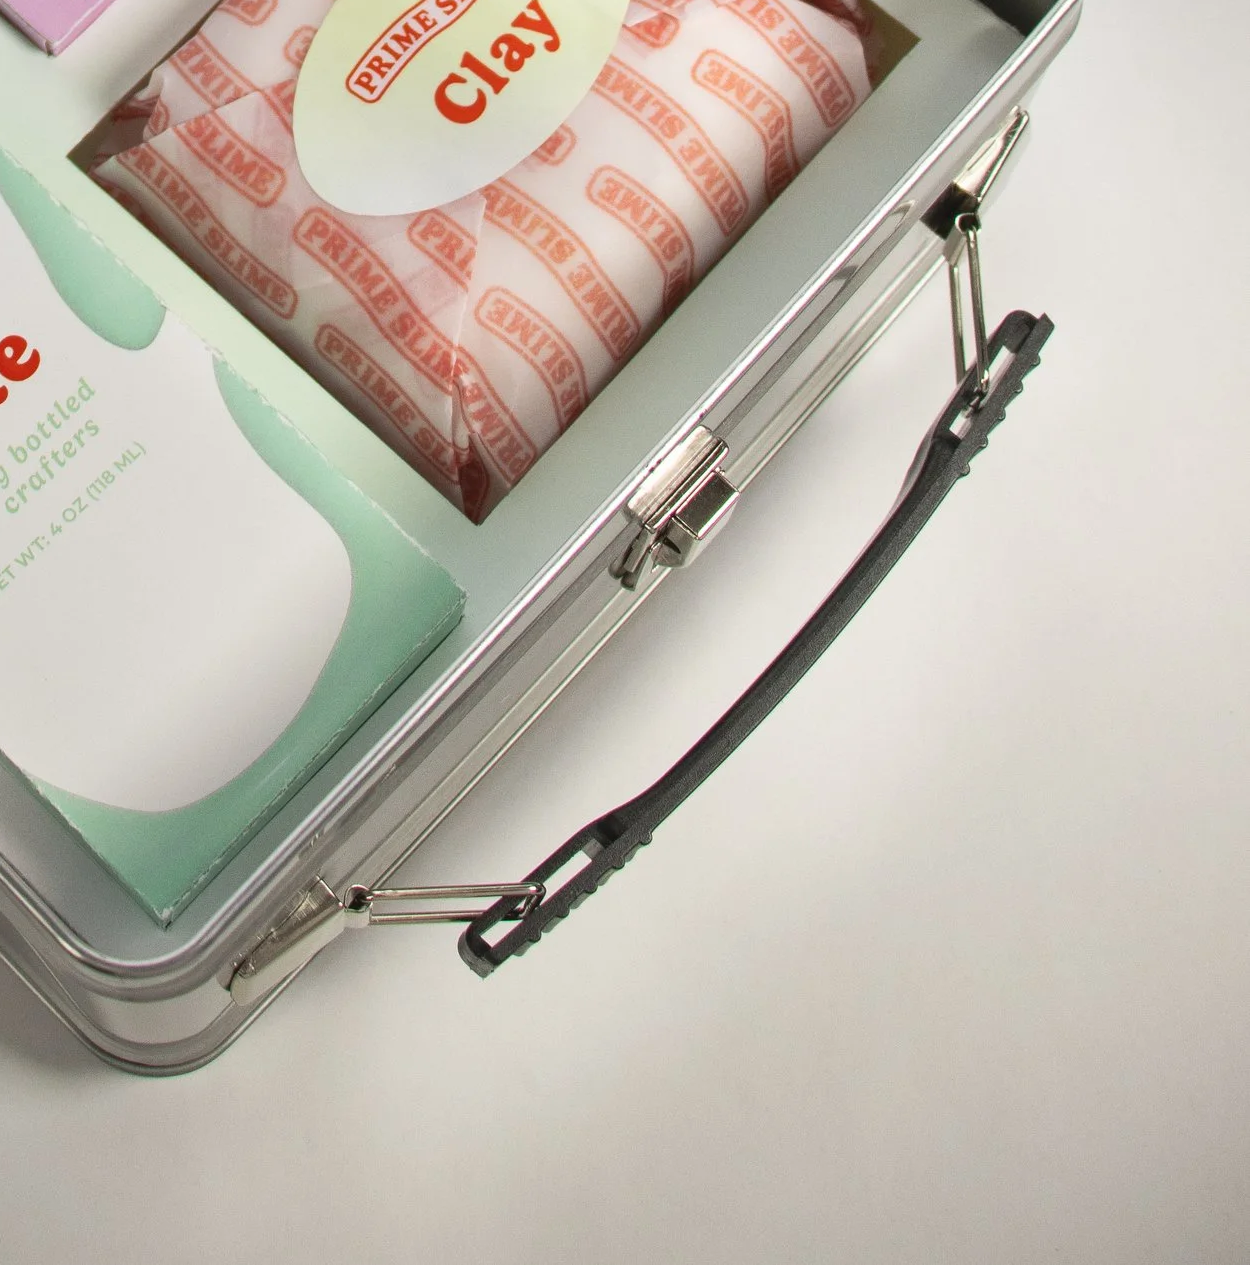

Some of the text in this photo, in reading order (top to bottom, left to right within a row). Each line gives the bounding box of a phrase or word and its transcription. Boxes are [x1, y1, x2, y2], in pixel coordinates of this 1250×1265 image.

[354, 9, 438, 95] PRIME
[701, 58, 786, 136] SLIME
[778, 28, 850, 120] PRIME
[600, 176, 685, 262] SLIME
[680, 137, 748, 231] PRIME
[204, 227, 288, 307] SLIME
[305, 216, 399, 314] PRIME
[390, 313, 469, 384] SLIM
[569, 262, 635, 354] PRIME
[322, 336, 416, 428] PRIME
[486, 298, 576, 386] SLIME
[7, 376, 96, 464] bottled
[461, 381, 533, 479] PRIME
[4, 419, 100, 514] crafters
[14, 533, 51, 569] WT:
[50, 522, 63, 537] 4
[62, 496, 89, 524] OZ
[87, 469, 117, 502] (118
[114, 440, 148, 473] ML)
